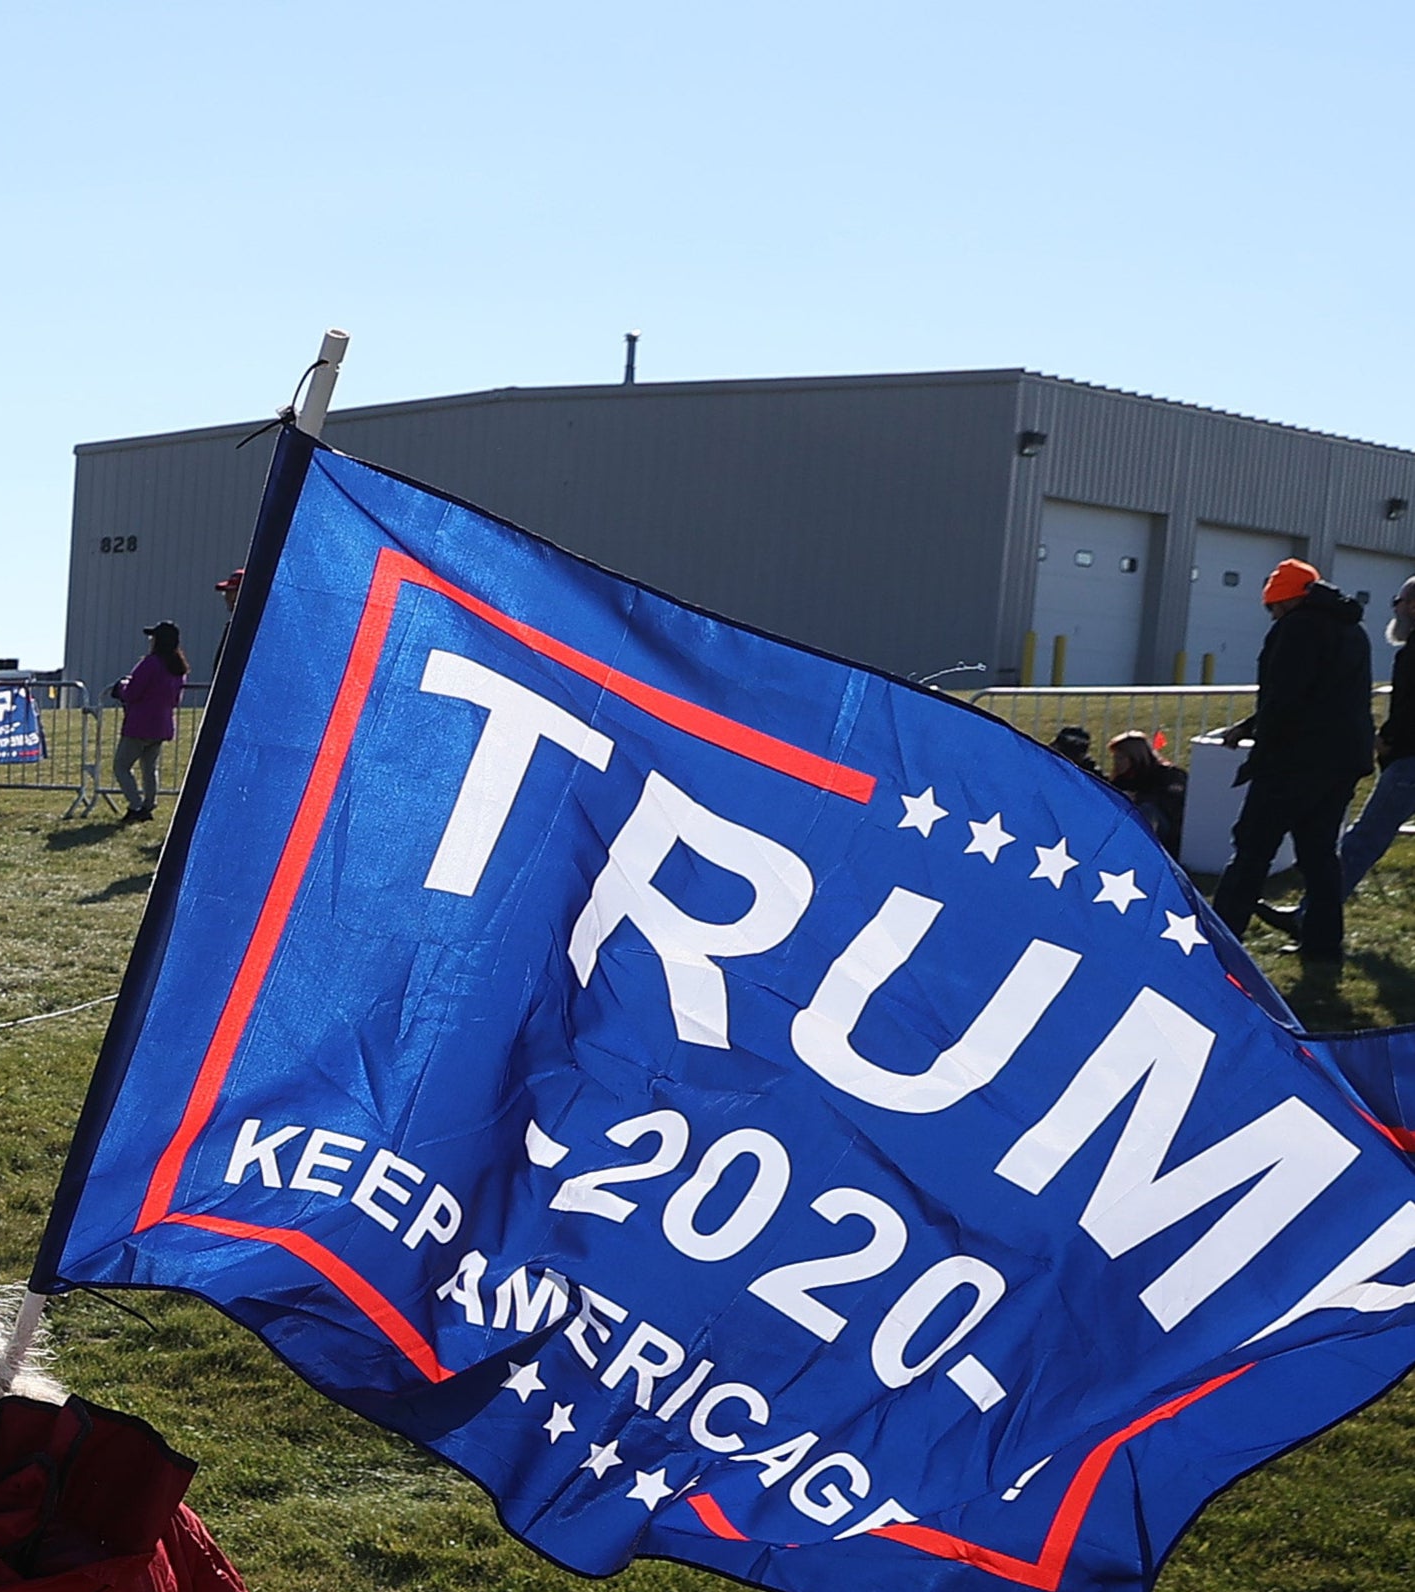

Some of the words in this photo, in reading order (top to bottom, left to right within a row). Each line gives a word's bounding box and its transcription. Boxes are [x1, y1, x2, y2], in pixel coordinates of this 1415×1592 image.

[100, 535, 138, 553] 828
[224, 1119, 462, 1250] KEEP
[436, 1249, 820, 1489] AMERICA
